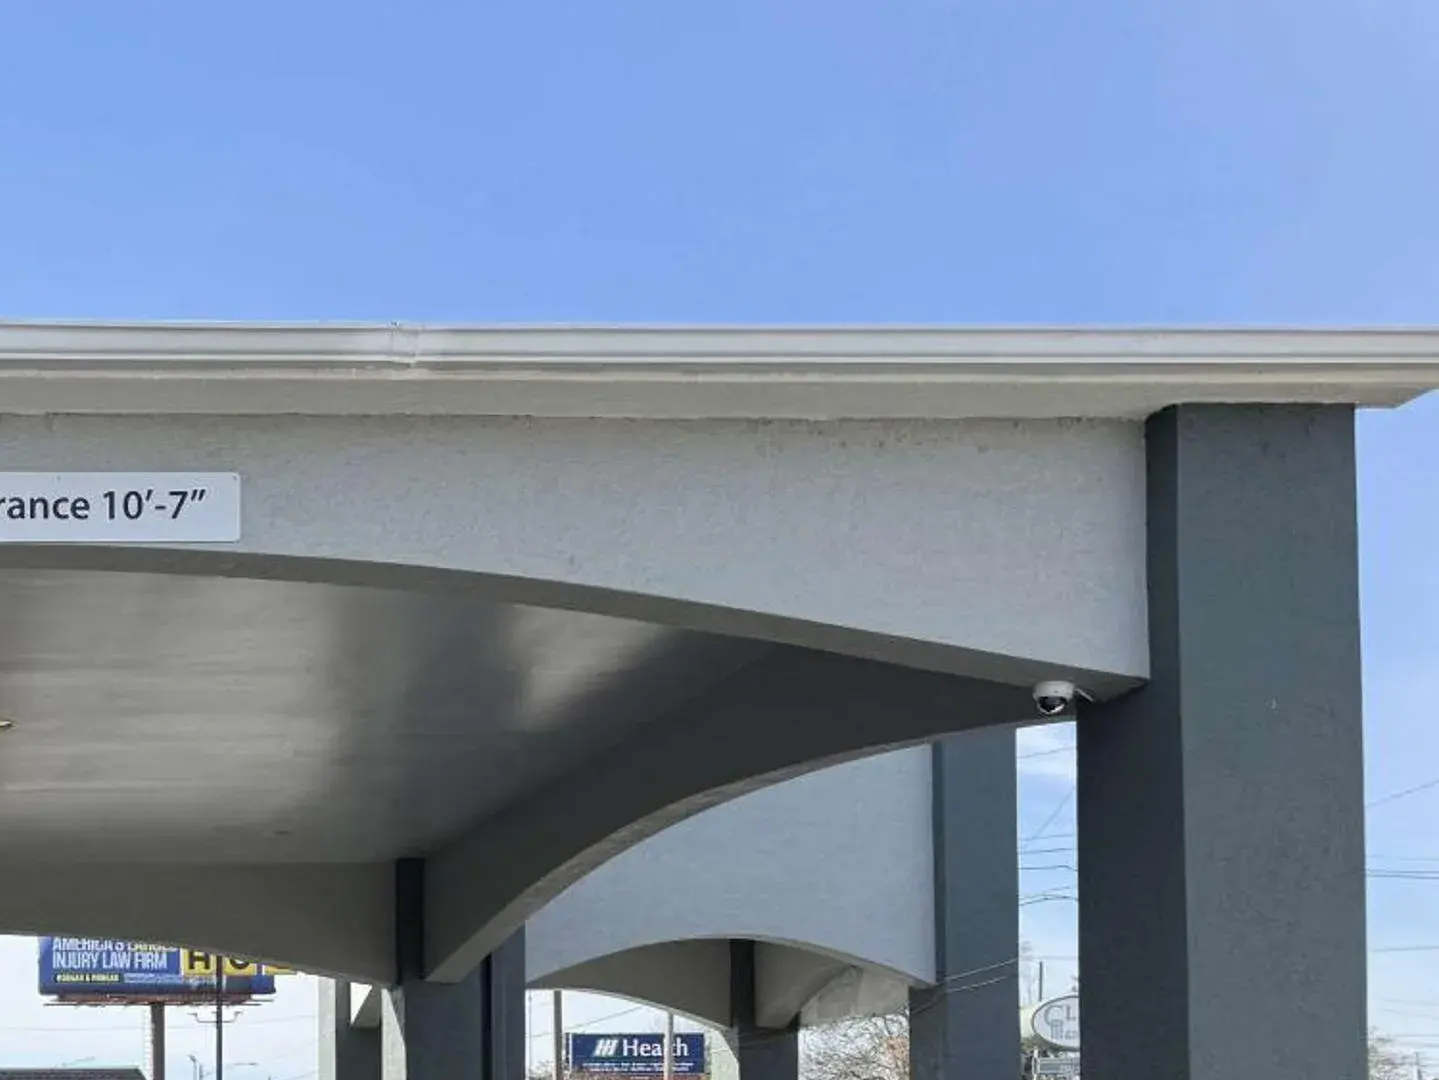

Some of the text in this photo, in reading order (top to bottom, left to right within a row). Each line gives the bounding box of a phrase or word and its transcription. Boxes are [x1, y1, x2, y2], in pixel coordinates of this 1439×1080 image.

[52, 951, 100, 970] INJURY
[102, 951, 131, 970] LAW
[134, 951, 168, 970] FIRM
[622, 1037, 689, 1057] Heah
